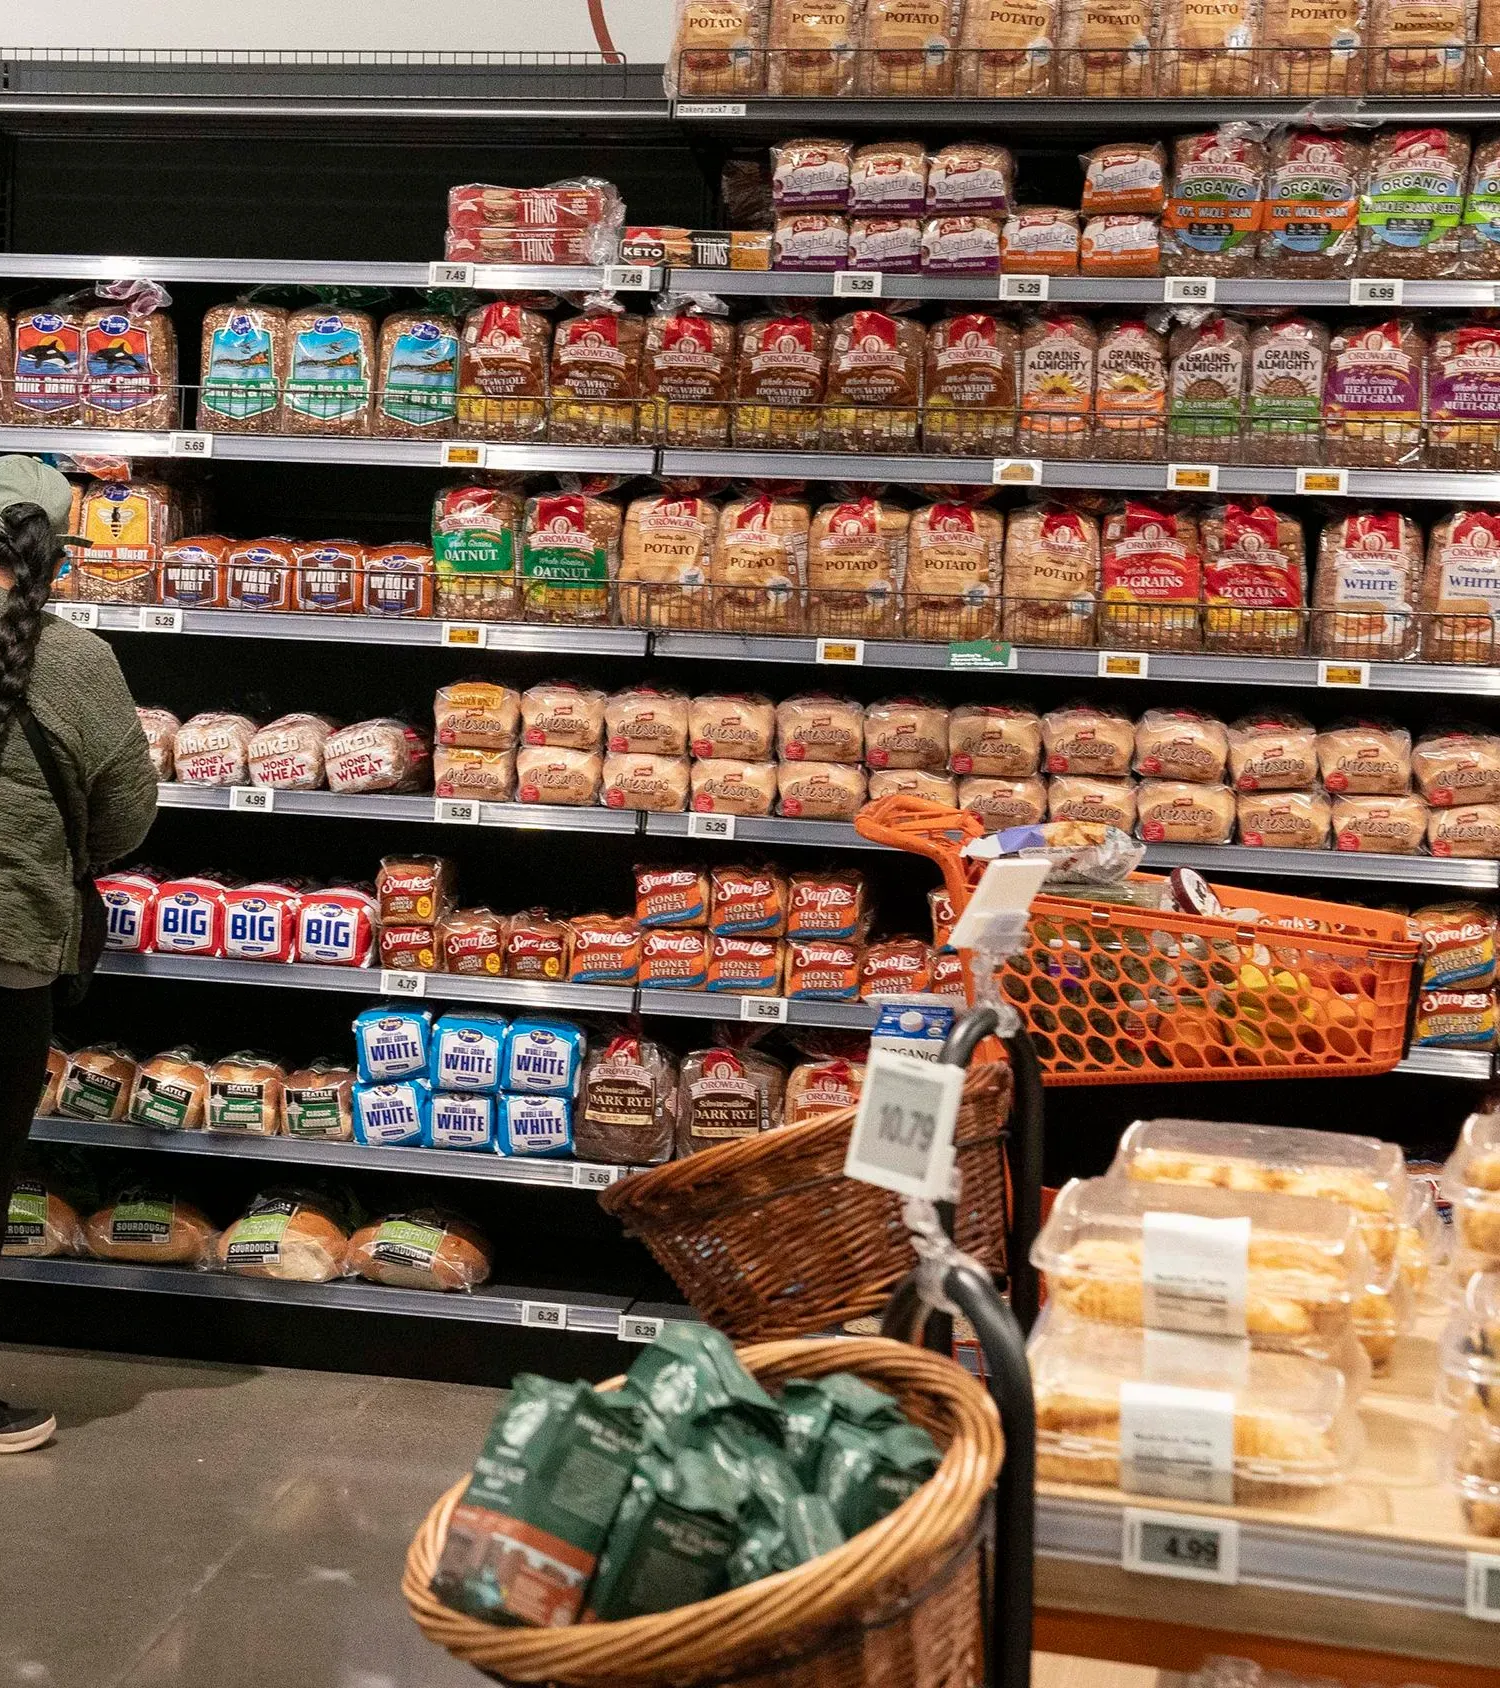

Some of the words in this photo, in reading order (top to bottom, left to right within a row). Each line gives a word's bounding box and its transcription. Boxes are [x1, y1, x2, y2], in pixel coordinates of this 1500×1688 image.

[1185, 4, 1238, 14] POTATO
[689, 18, 742, 28] POTATO
[792, 13, 845, 25] POTATO
[885, 12, 939, 24] POTATO
[990, 12, 1046, 26] POTATO
[1088, 13, 1140, 25] POTATO
[1190, 166, 1242, 174] OROWEAT
[1288, 165, 1341, 175] OROWEAT
[1389, 160, 1443, 171] OROWEAT
[1184, 181, 1247, 198] ORGANIC
[1281, 182, 1342, 198] ORGANIC
[1381, 177, 1448, 194] ORGANIC
[523, 199, 557, 224] THINS
[521, 238, 555, 262] THINS
[623, 247, 663, 257] KETO
[697, 244, 727, 266] THINS
[446, 270, 466, 280] 7.49
[621, 274, 641, 284] 7.49
[852, 281, 873, 290] 5.29
[1018, 284, 1040, 293] 5.29
[1183, 286, 1206, 295] 6.99
[1370, 288, 1394, 298] 6.99
[568, 350, 618, 359] OROWEAT
[762, 354, 812, 364] OROWEAT
[1037, 351, 1080, 360] GRAINS
[1186, 352, 1230, 362] GRAINS
[1264, 350, 1310, 360] GRAINS
[1348, 352, 1399, 361] OROWEAT
[1030, 361, 1090, 370] ALMIGHTY
[1178, 362, 1240, 372] ALMIGHTY
[1256, 360, 1319, 370] ALMIGHTY
[1345, 386, 1395, 394] HEALTHY
[952, 392, 986, 400] WHEAT
[1335, 394, 1404, 404] MULTI-GRAIN
[184, 441, 204, 450] 5.69
[538, 536, 585, 544] OROWEAT
[644, 543, 694, 555] POTATO
[1126, 541, 1177, 551] OROWEAT
[444, 549, 498, 561] OATNUT
[825, 560, 878, 571] POTATO
[925, 559, 976, 571] POTATO
[168, 569, 211, 582] WHOLE
[532, 566, 590, 578] OATNUT
[1034, 566, 1084, 582] POTATO
[1116, 576, 1129, 587] 12
[1130, 575, 1183, 588] GRAINS
[1345, 578, 1397, 591] WHITE
[71, 612, 90, 622] 5.79
[155, 616, 174, 626] 5.29
[179, 734, 230, 754] NAKED
[192, 756, 224, 767] HONEY
[262, 757, 296, 770] HONEY
[187, 762, 235, 780] WHEAT
[258, 764, 306, 783] WHEAT
[246, 795, 265, 805] 4.99
[452, 806, 472, 819] 5.29
[705, 821, 728, 833] 5.29
[646, 892, 687, 905] HONEY
[647, 900, 688, 914] WHEAT
[112, 909, 136, 933] IG
[163, 907, 207, 936] BIG
[230, 914, 274, 942] BIG
[306, 918, 351, 948] BIG
[583, 952, 623, 963] HONEY
[582, 961, 623, 971] WHEAT
[719, 961, 761, 970] HONEY
[719, 968, 761, 977] WHEAT
[397, 978, 418, 990] 4.79
[758, 1005, 779, 1016] 5.29
[370, 1041, 419, 1061] WHITE
[445, 1054, 492, 1074] WHITE
[516, 1054, 564, 1076] WHITE
[598, 1067, 643, 1078] OROWEAT
[227, 1085, 259, 1094] SEATTLE
[590, 1095, 620, 1107] DARK
[622, 1097, 652, 1108] RYE
[694, 1109, 727, 1121] DARK
[728, 1109, 757, 1120] RYE
[437, 1113, 484, 1131] WHITE
[513, 1118, 562, 1135] WHITE
[589, 1173, 610, 1184] 5.69
[116, 1222, 166, 1233] SOURDOUGH
[229, 1243, 276, 1255] SOURDOUGH
[538, 1309, 559, 1323] 6.29
[635, 1322, 656, 1336] 6.29
